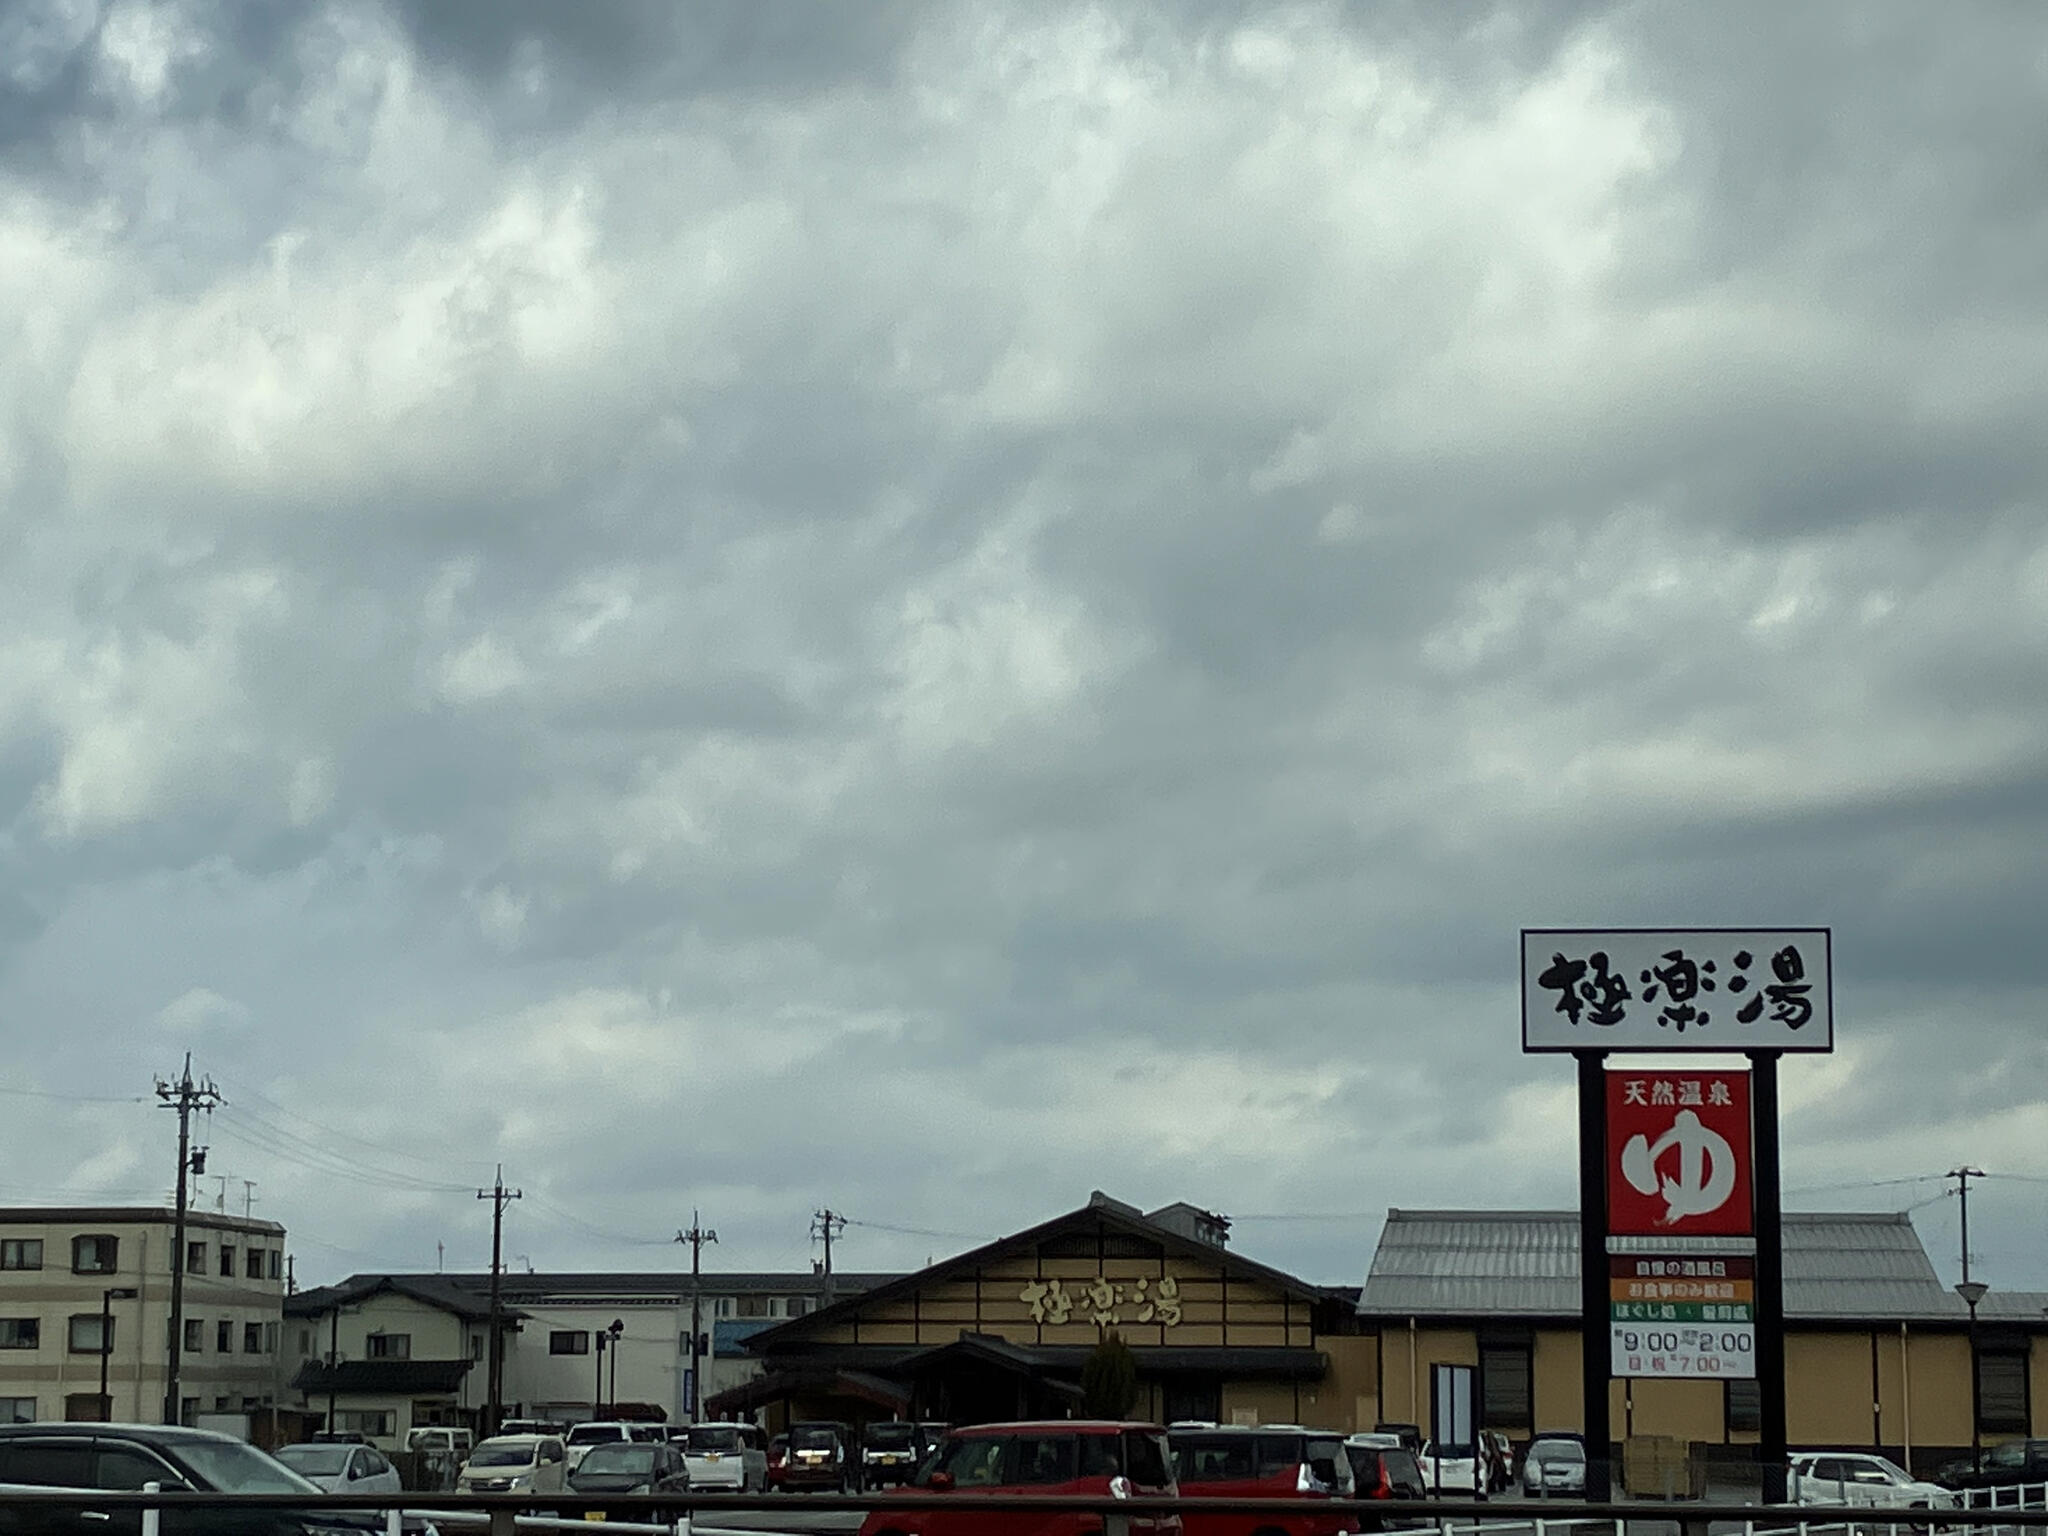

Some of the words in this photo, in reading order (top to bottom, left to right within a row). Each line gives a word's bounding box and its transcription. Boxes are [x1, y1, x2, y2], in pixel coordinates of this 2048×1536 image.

[1539, 945, 1814, 1033] 極楽湯
[1624, 1079, 1734, 1107] 天然温泉
[1621, 1109, 1736, 1226] ゆ
[1019, 1276, 1182, 1327] 極楽湯
